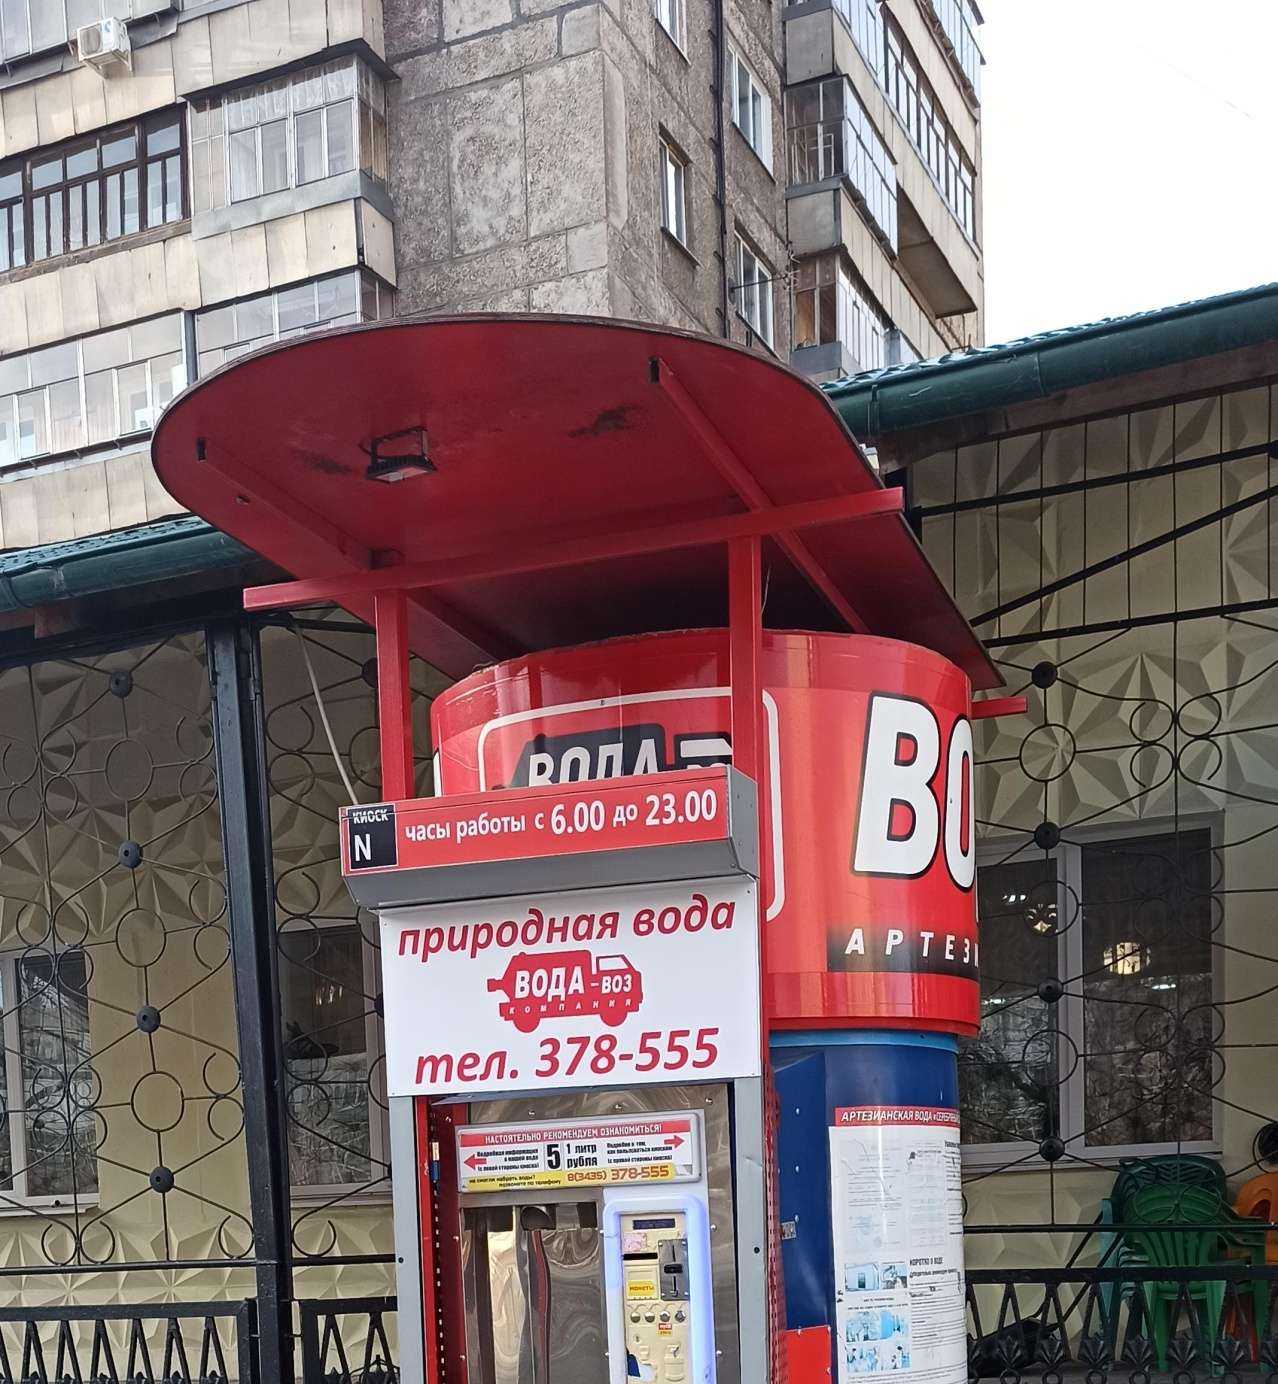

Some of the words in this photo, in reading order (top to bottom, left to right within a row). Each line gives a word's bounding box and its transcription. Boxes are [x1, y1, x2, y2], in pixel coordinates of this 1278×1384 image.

[852, 693, 977, 891] ВО
[351, 808, 388, 824] КИОСК
[405, 821, 450, 842] часы
[456, 812, 526, 843] работы
[534, 814, 544, 830] с
[550, 799, 605, 834] 6.00
[612, 804, 638, 828] до
[645, 789, 717, 826] 23.00
[354, 833, 371, 861] N
[398, 907, 620, 963] природная
[633, 893, 736, 936] вода
[509, 998, 632, 1014] КОМПАНИЯ
[415, 1049, 519, 1084] тел.
[535, 1027, 719, 1078] 378-555
[841, 1110, 914, 1122] АРТЕЗИАНСКАЯ
[914, 1110, 933, 1123] ВОДА
[485, 1132, 541, 1144] НАСТОЯТЕЛЬНО
[543, 1128, 599, 1140] РЕКОМЕНДУЕМ
[600, 1123, 662, 1137] ОЗНАКОМИТЬСЯ!
[546, 1143, 561, 1170] 5
[566, 1143, 571, 1154] 1
[574, 1144, 597, 1154] литр
[566, 1155, 598, 1168] рубля
[567, 1170, 607, 1182] 8(3435)
[611, 1165, 669, 1180] 378-555
